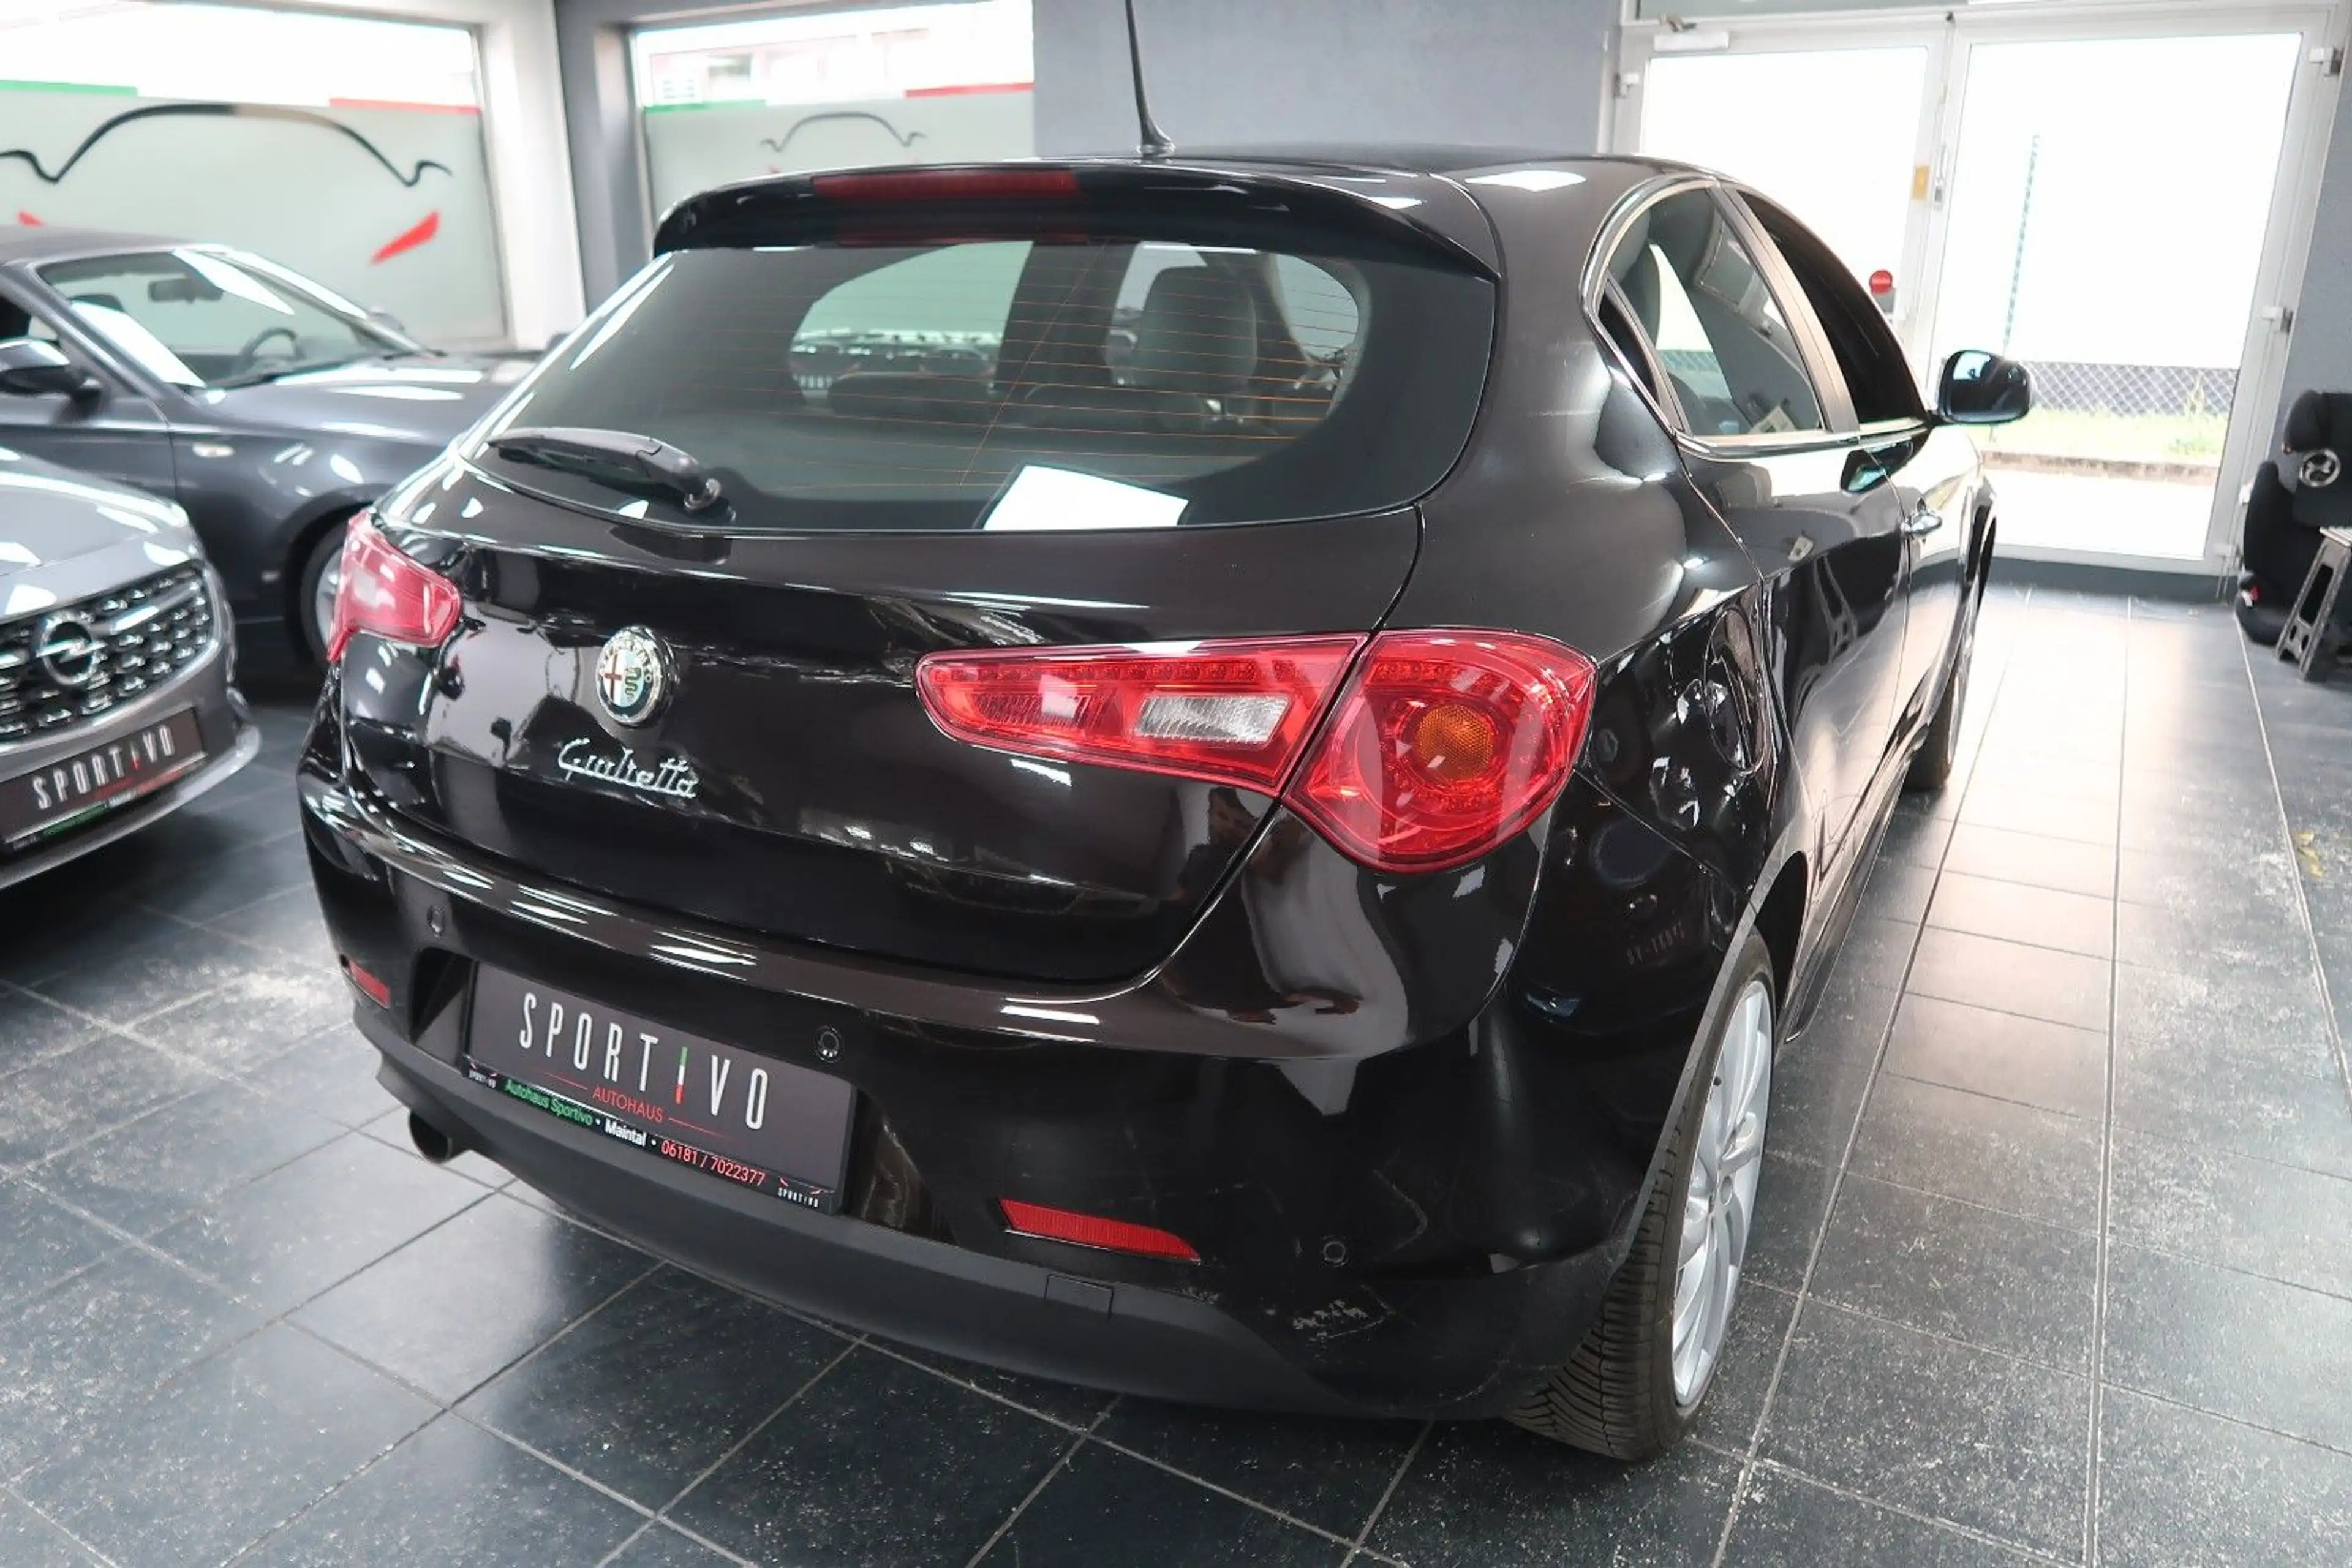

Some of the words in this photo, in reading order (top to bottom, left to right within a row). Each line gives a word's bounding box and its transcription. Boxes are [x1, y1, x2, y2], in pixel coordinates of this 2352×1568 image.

[33, 724, 175, 810] SPORTIVO
[558, 737, 699, 798] Giulietta
[519, 992, 769, 1129] SPORTIVO
[505, 1079, 549, 1109] Autohaus
[550, 1099, 593, 1126] Sportivo
[605, 1118, 647, 1147] Maintal
[662, 1140, 698, 1164] 06181
[710, 1156, 765, 1186] 7022377
[592, 1086, 663, 1123] AUTOHAUS
